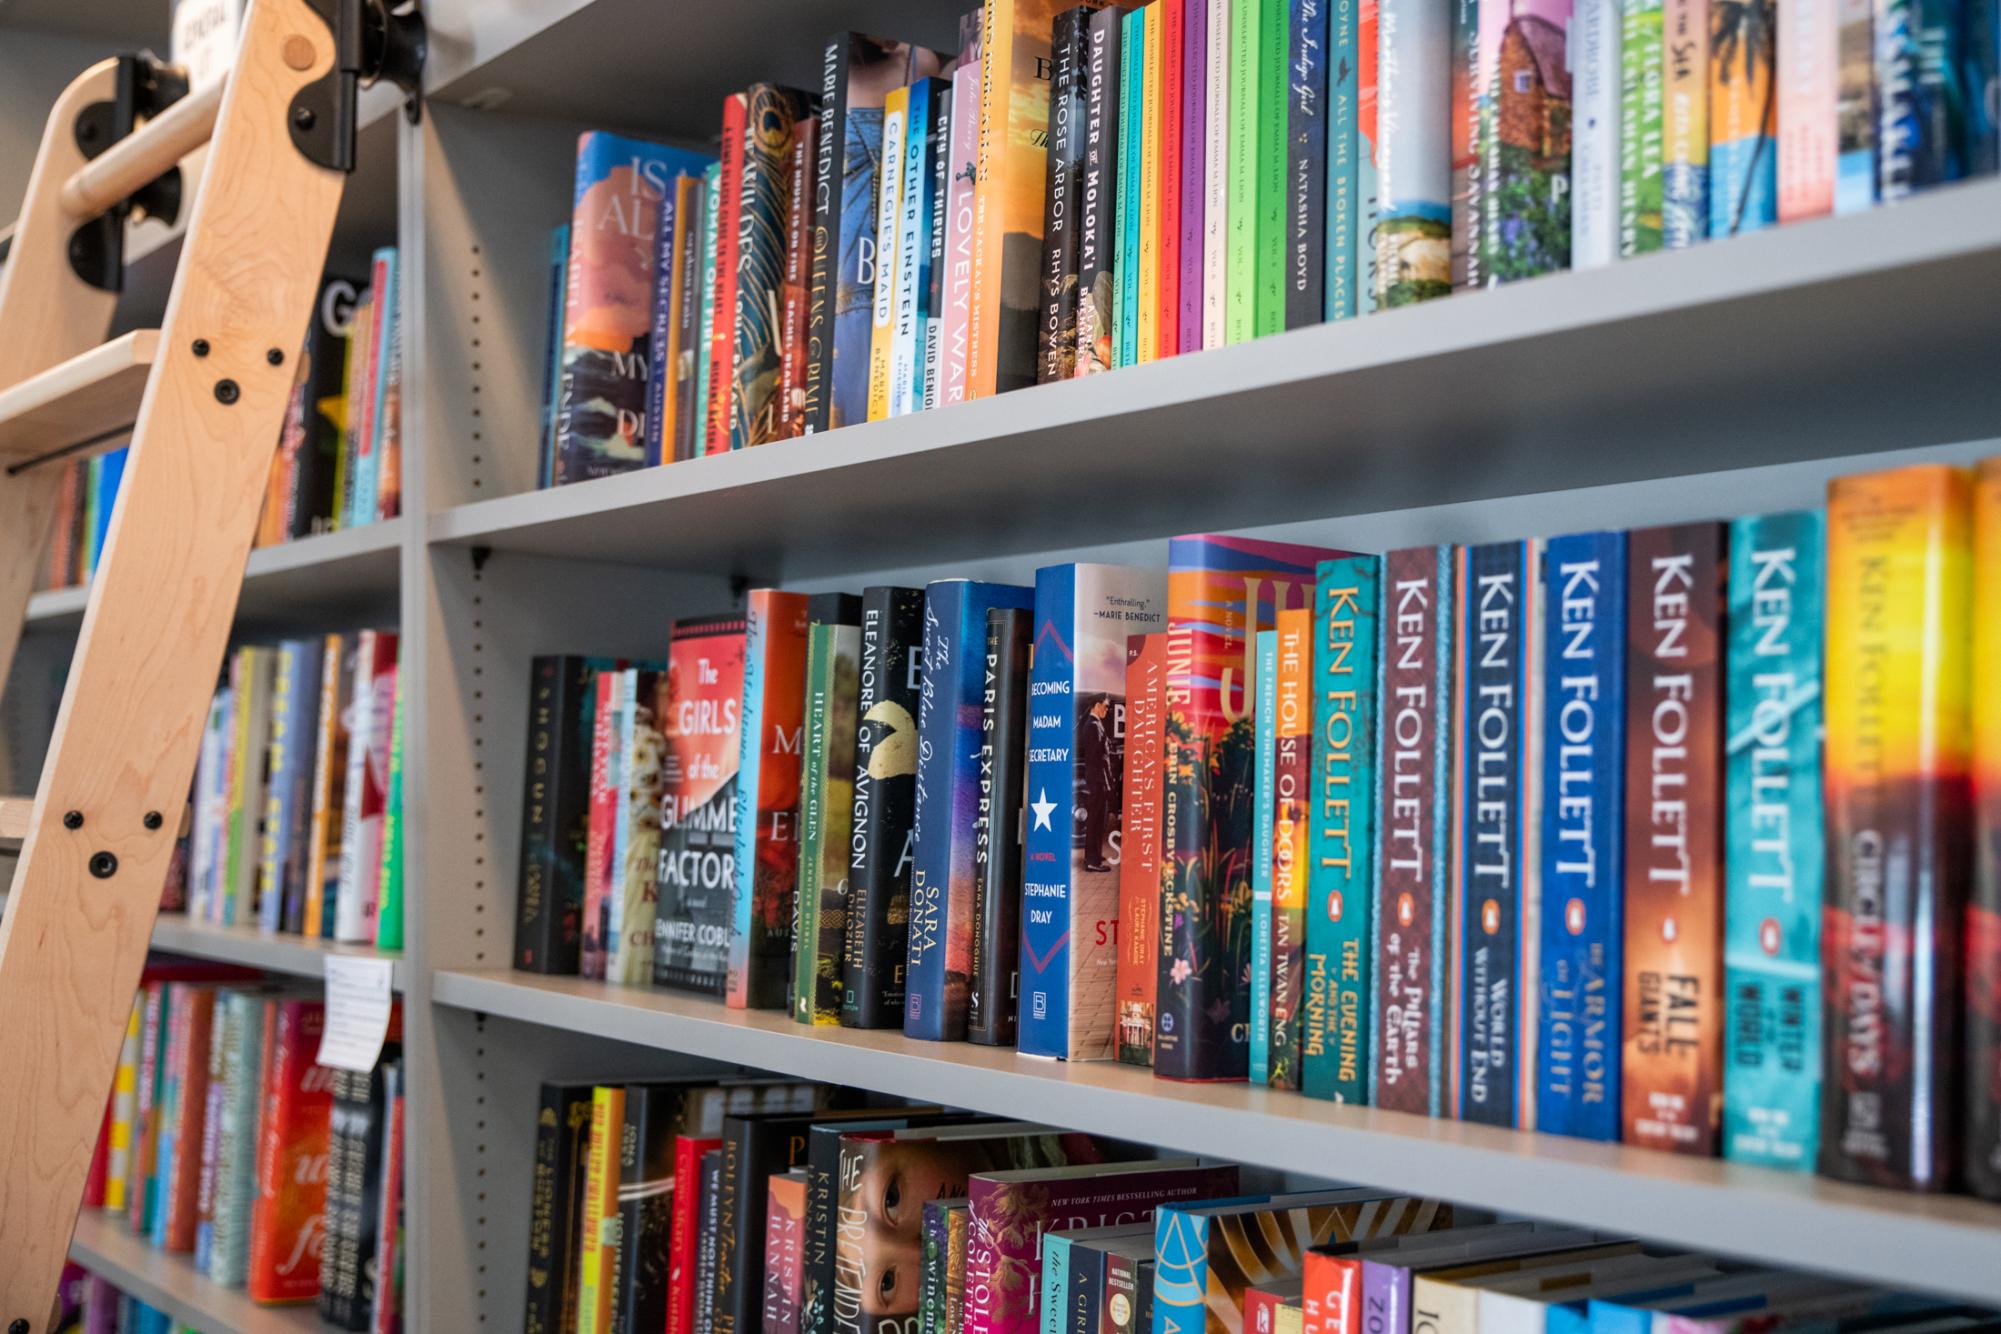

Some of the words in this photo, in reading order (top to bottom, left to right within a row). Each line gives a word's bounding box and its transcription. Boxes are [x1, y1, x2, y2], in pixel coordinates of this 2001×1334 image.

[822, 44, 838, 104] MARIE
[1058, 43, 1071, 88] THE
[1089, 29, 1105, 145] DAUGHTER
[1294, 28, 1318, 81] Indigo
[912, 104, 921, 133] THE
[1056, 94, 1069, 151] ROSE
[1292, 83, 1315, 117] Girl
[1337, 95, 1347, 126] ALL
[795, 142, 804, 165] THE
[815, 108, 835, 216] BENEDICT
[936, 115, 948, 154] CITY
[1336, 132, 1347, 166] THE
[793, 170, 802, 211] HOUSE
[881, 121, 898, 253] CARNEGIE'S
[906, 143, 919, 222] OTHER
[935, 160, 945, 180] OF
[1052, 158, 1066, 232] ARBOR
[1297, 159, 1309, 239] NATASHA
[661, 201, 674, 237] ALL
[705, 172, 722, 258] WOMAN
[1083, 172, 1099, 271] MOLOKA'I
[1335, 177, 1347, 248] BROKEN
[1466, 164, 1481, 287] SAVANNAH
[704, 267, 717, 300] ON
[789, 252, 798, 281] FIRE
[900, 230, 914, 336] EINSTEIN
[952, 191, 974, 311] LOVELY
[974, 226, 985, 302] JACKAL'S
[1050, 249, 1061, 297] RHYS
[1296, 243, 1308, 291] BOYD
[877, 263, 889, 320] MAID
[1334, 255, 1345, 320] PLACES
[701, 312, 714, 352] FIRE
[784, 300, 796, 349] RACHEL
[926, 325, 937, 364] DAVID
[969, 304, 981, 377] MISTRESS
[1047, 303, 1059, 375] BOWEN
[1077, 286, 1089, 364] BRENNERT
[781, 353, 793, 423] BEANLAND
[947, 322, 969, 402] WAR
[1125, 611, 1161, 623] BENEDICT
[1328, 586, 1359, 674] KEN
[1395, 578, 1429, 670] KEN
[1477, 572, 1514, 669] KEN
[1559, 559, 1600, 660] KEN
[1652, 553, 1694, 658] KEN
[1749, 546, 1797, 656] KEN
[859, 609, 879, 712] ELEANORE
[922, 596, 940, 677] Sweet
[935, 636, 949, 671] The
[1166, 622, 1193, 706] JUNIE
[1265, 651, 1273, 672] THE
[1283, 627, 1299, 673] THE
[697, 658, 719, 685] The
[919, 675, 935, 729] Blue
[982, 653, 998, 732] PARIS
[1030, 680, 1070, 696] BECOMING
[1264, 676, 1273, 724] FRENCH
[678, 698, 737, 737] GIRLS
[812, 692, 824, 758] HEART
[858, 725, 871, 753] OF
[1033, 715, 1061, 729] MADAM
[1144, 660, 1159, 790] AMERICA'S
[1280, 680, 1297, 765] HOUSE
[687, 754, 701, 779] of
[701, 754, 720, 780] the
[1028, 748, 1069, 762] SECRETARY
[1131, 699, 1145, 832] DAUGHTER
[1167, 742, 1178, 785] ERIN
[1262, 728, 1272, 809] WINEMAKER'S
[1321, 690, 1356, 880] FOLLETT
[1390, 684, 1427, 882] FOLLETT
[1474, 684, 1513, 889] FOLLETT
[1555, 674, 1599, 889] FOLLETT
[1648, 673, 1694, 897] FOLLETT
[1747, 671, 1796, 904] FOLLETT
[660, 793, 737, 833] GLIMME
[807, 800, 818, 841] GLEN
[851, 765, 869, 869] AVIGNON
[913, 735, 933, 843] Distance
[976, 745, 993, 864] EXPRESS
[1278, 774, 1296, 812] OF
[1142, 801, 1155, 873] FIRST
[1165, 791, 1178, 861] CROSBY
[1261, 813, 1270, 878] DAUGHTER
[658, 847, 735, 890] FACTOR
[1024, 882, 1066, 898] STEPHANIE
[1276, 819, 1294, 900] DOORS
[911, 869, 926, 966] DONATI
[923, 886, 940, 951] SARA
[975, 877, 984, 909] EMMA
[1030, 910, 1053, 924] DRAY
[1163, 868, 1176, 957] ECKSTINE
[853, 888, 868, 969] ELIZABETH
[972, 912, 982, 977] DONOGHUE
[1259, 913, 1268, 966] LORETTA
[1277, 912, 1290, 947] TAN
[1341, 937, 1360, 982] THE
[1257, 970, 1267, 1041] ELLSWORTH
[1275, 952, 1289, 1002] TWAN
[1304, 953, 1326, 1056] MORNING
[1327, 979, 1338, 1005] AND
[1472, 945, 1490, 1043] WITHOUT
[1273, 1006, 1287, 1047] ENG
[1327, 1010, 1337, 1033] THE
[1338, 990, 1358, 1082] EVENING
[1489, 978, 1508, 1068] WORLD
[1549, 987, 1574, 1098] LIGHT
[1582, 976, 1606, 1104] ARMOR
[1636, 970, 1661, 1056] GIANTS
[1665, 973, 1700, 1055] FALL
[1470, 1049, 1489, 1104] END
[710, 1168, 720, 1190] WE
[839, 1149, 865, 1192] THE
[1051, 1197, 1069, 1207] NEW
[1071, 1195, 1090, 1206] YORK
[1093, 1193, 1115, 1203] TIMES
[1116, 1189, 1165, 1201] BESTSELLING
[1167, 1186, 1197, 1197] AUTHOR
[708, 1193, 719, 1234] MUST
[813, 1171, 830, 1265] KRISTIN
[927, 1219, 938, 1257] the
[706, 1237, 717, 1268] NOT
[765, 1214, 783, 1320] HANNAH
[780, 1220, 796, 1326] KRISTIN
[964, 1221, 978, 1327] COLETTE
[1052, 1249, 1063, 1278] the
[1078, 1272, 1088, 1284] A
[1108, 1279, 1135, 1291] BESTSELLER
[1111, 1267, 1131, 1280] NATIONAL
[704, 1272, 715, 1316] THINK
